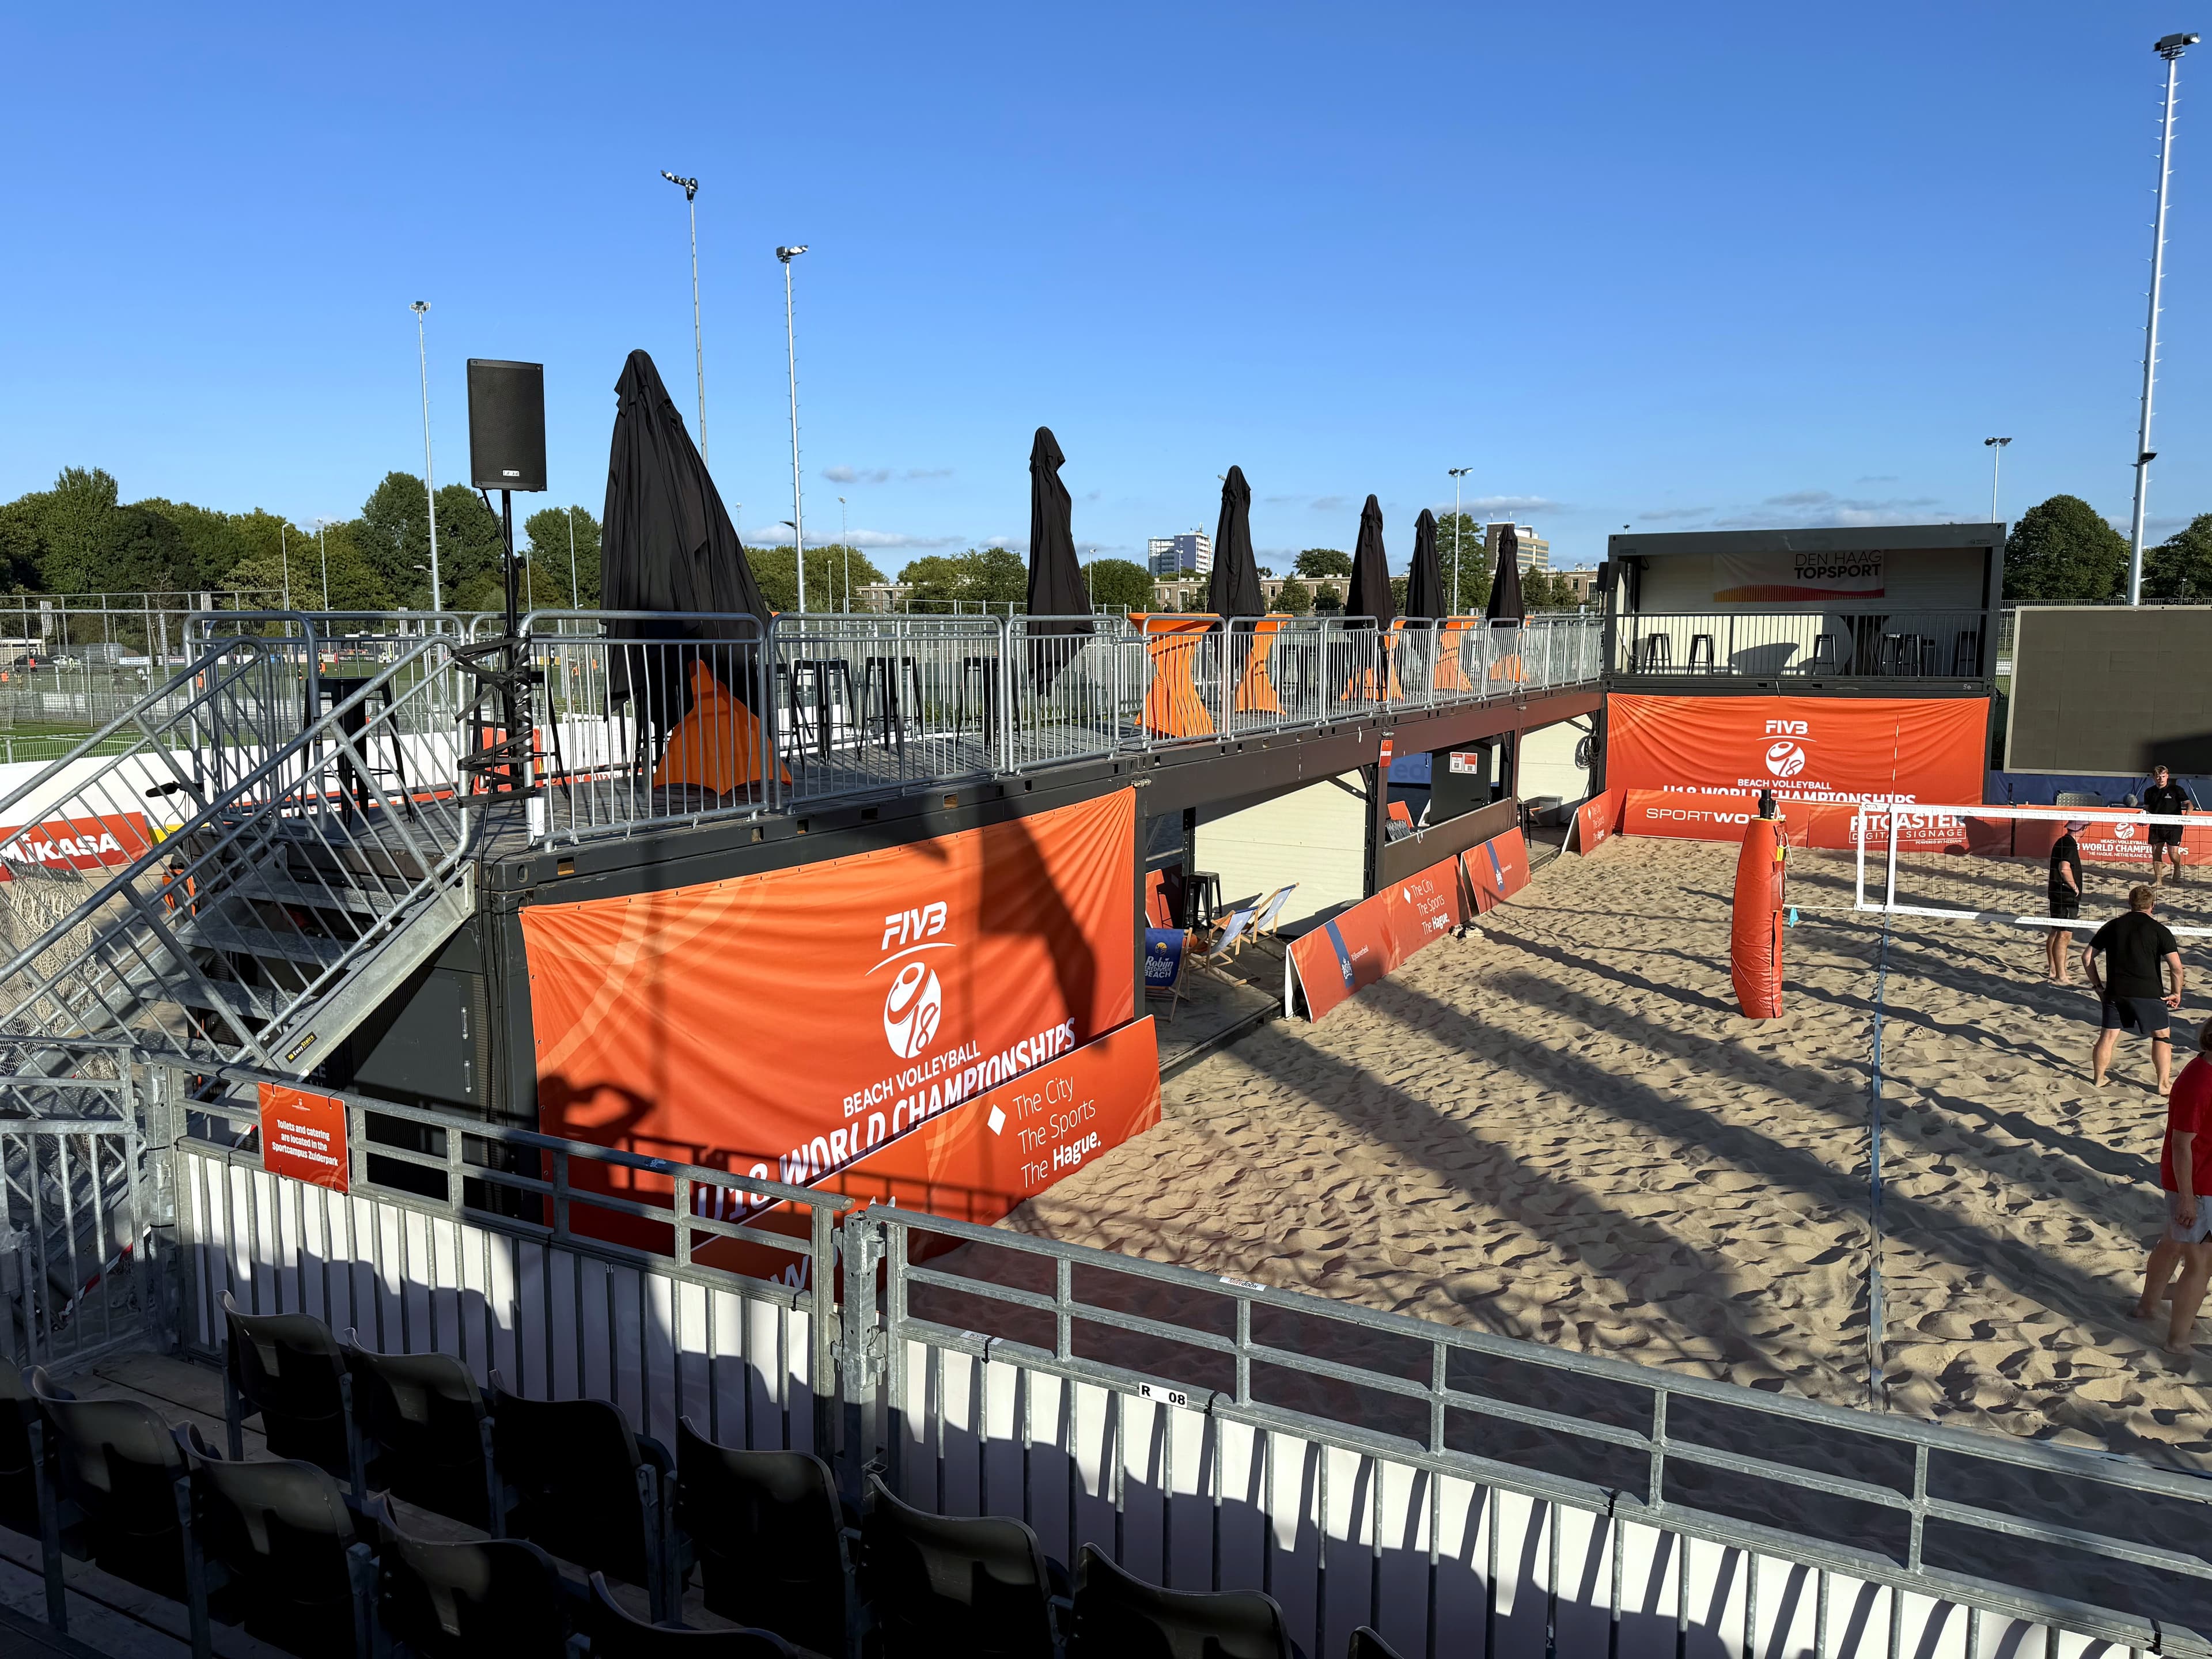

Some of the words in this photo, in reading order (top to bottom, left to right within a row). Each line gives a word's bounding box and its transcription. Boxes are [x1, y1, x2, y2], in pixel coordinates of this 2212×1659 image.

[1796, 552, 1828, 566] DEN
[1835, 550, 1881, 565] HAAG
[1794, 563, 1881, 579] TOPSPORT
[1766, 719, 1808, 734] FIVB
[1737, 779, 1770, 787] BEACH
[1772, 780, 1832, 790] VOLLEYBALL
[1906, 829, 1963, 838] SIGNAGE
[2082, 843, 2113, 852] WORLD
[1411, 884, 1422, 899] The
[1422, 879, 1434, 893] City
[1416, 903, 1429, 917] The
[1427, 895, 1445, 912] Sports
[881, 900, 946, 950] FIVB
[1422, 921, 1433, 935] The
[843, 1077, 893, 1118] BEACH
[896, 1040, 981, 1094] VOLLEYBALL
[779, 1114, 886, 1185] WORLD
[892, 1017, 1075, 1138] CHAMPIONSHIPS
[1013, 1093, 1042, 1120] The
[1046, 1076, 1073, 1104] City
[276, 1119, 295, 1132] Toilets
[296, 1125, 306, 1135] and
[306, 1128, 330, 1141] catering
[1017, 1127, 1046, 1154] The
[1050, 1100, 1096, 1139] Sports
[281, 1133, 290, 1142] are
[290, 1133, 310, 1147] located
[311, 1139, 317, 1149] in
[317, 1141, 327, 1152] the
[272, 1142, 308, 1159] Sportcampus
[308, 1150, 339, 1166] Zuiderpark
[1021, 1160, 1048, 1188] The
[1053, 1131, 1101, 1171] Hague.
[1141, 1385, 1150, 1397] R
[1169, 1392, 1185, 1406] 08
